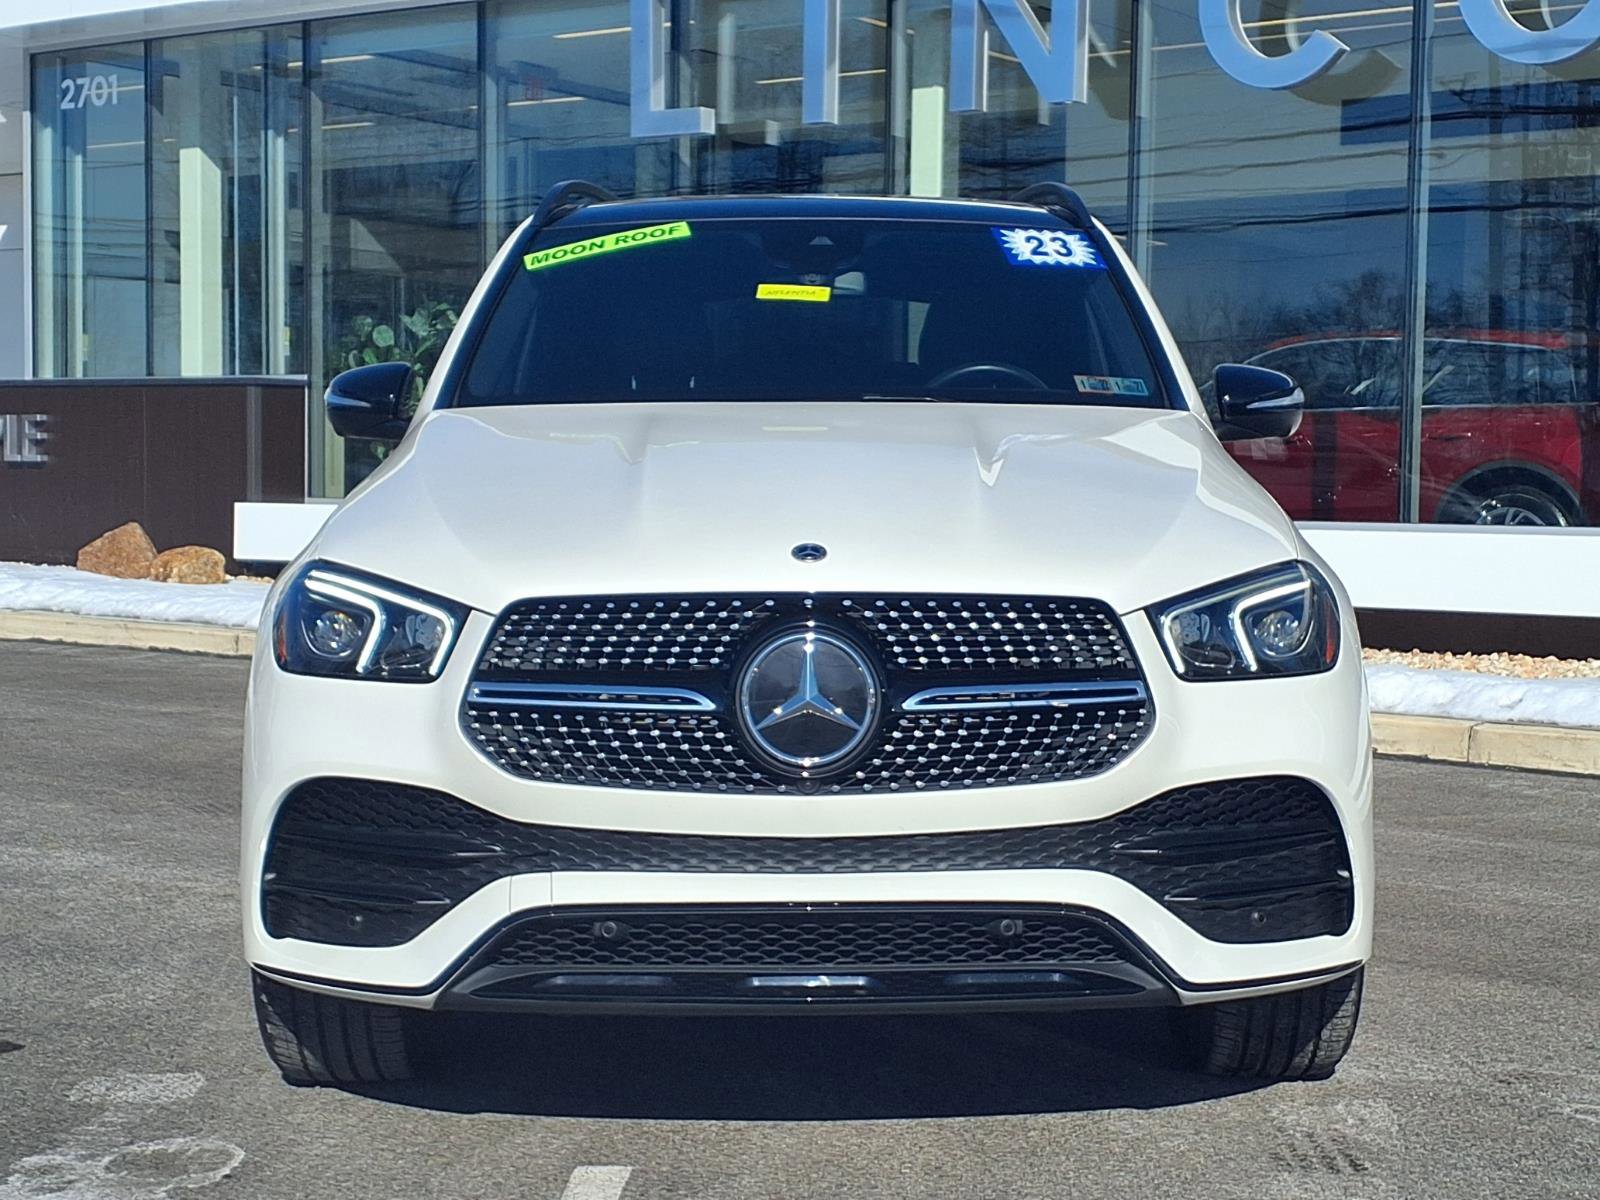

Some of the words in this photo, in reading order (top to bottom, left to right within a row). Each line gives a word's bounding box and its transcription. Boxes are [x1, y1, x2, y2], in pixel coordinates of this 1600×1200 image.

[60, 74, 118, 110] 2701
[530, 239, 606, 266] MOON
[613, 225, 682, 245] ROOF
[1024, 235, 1073, 257] 23
